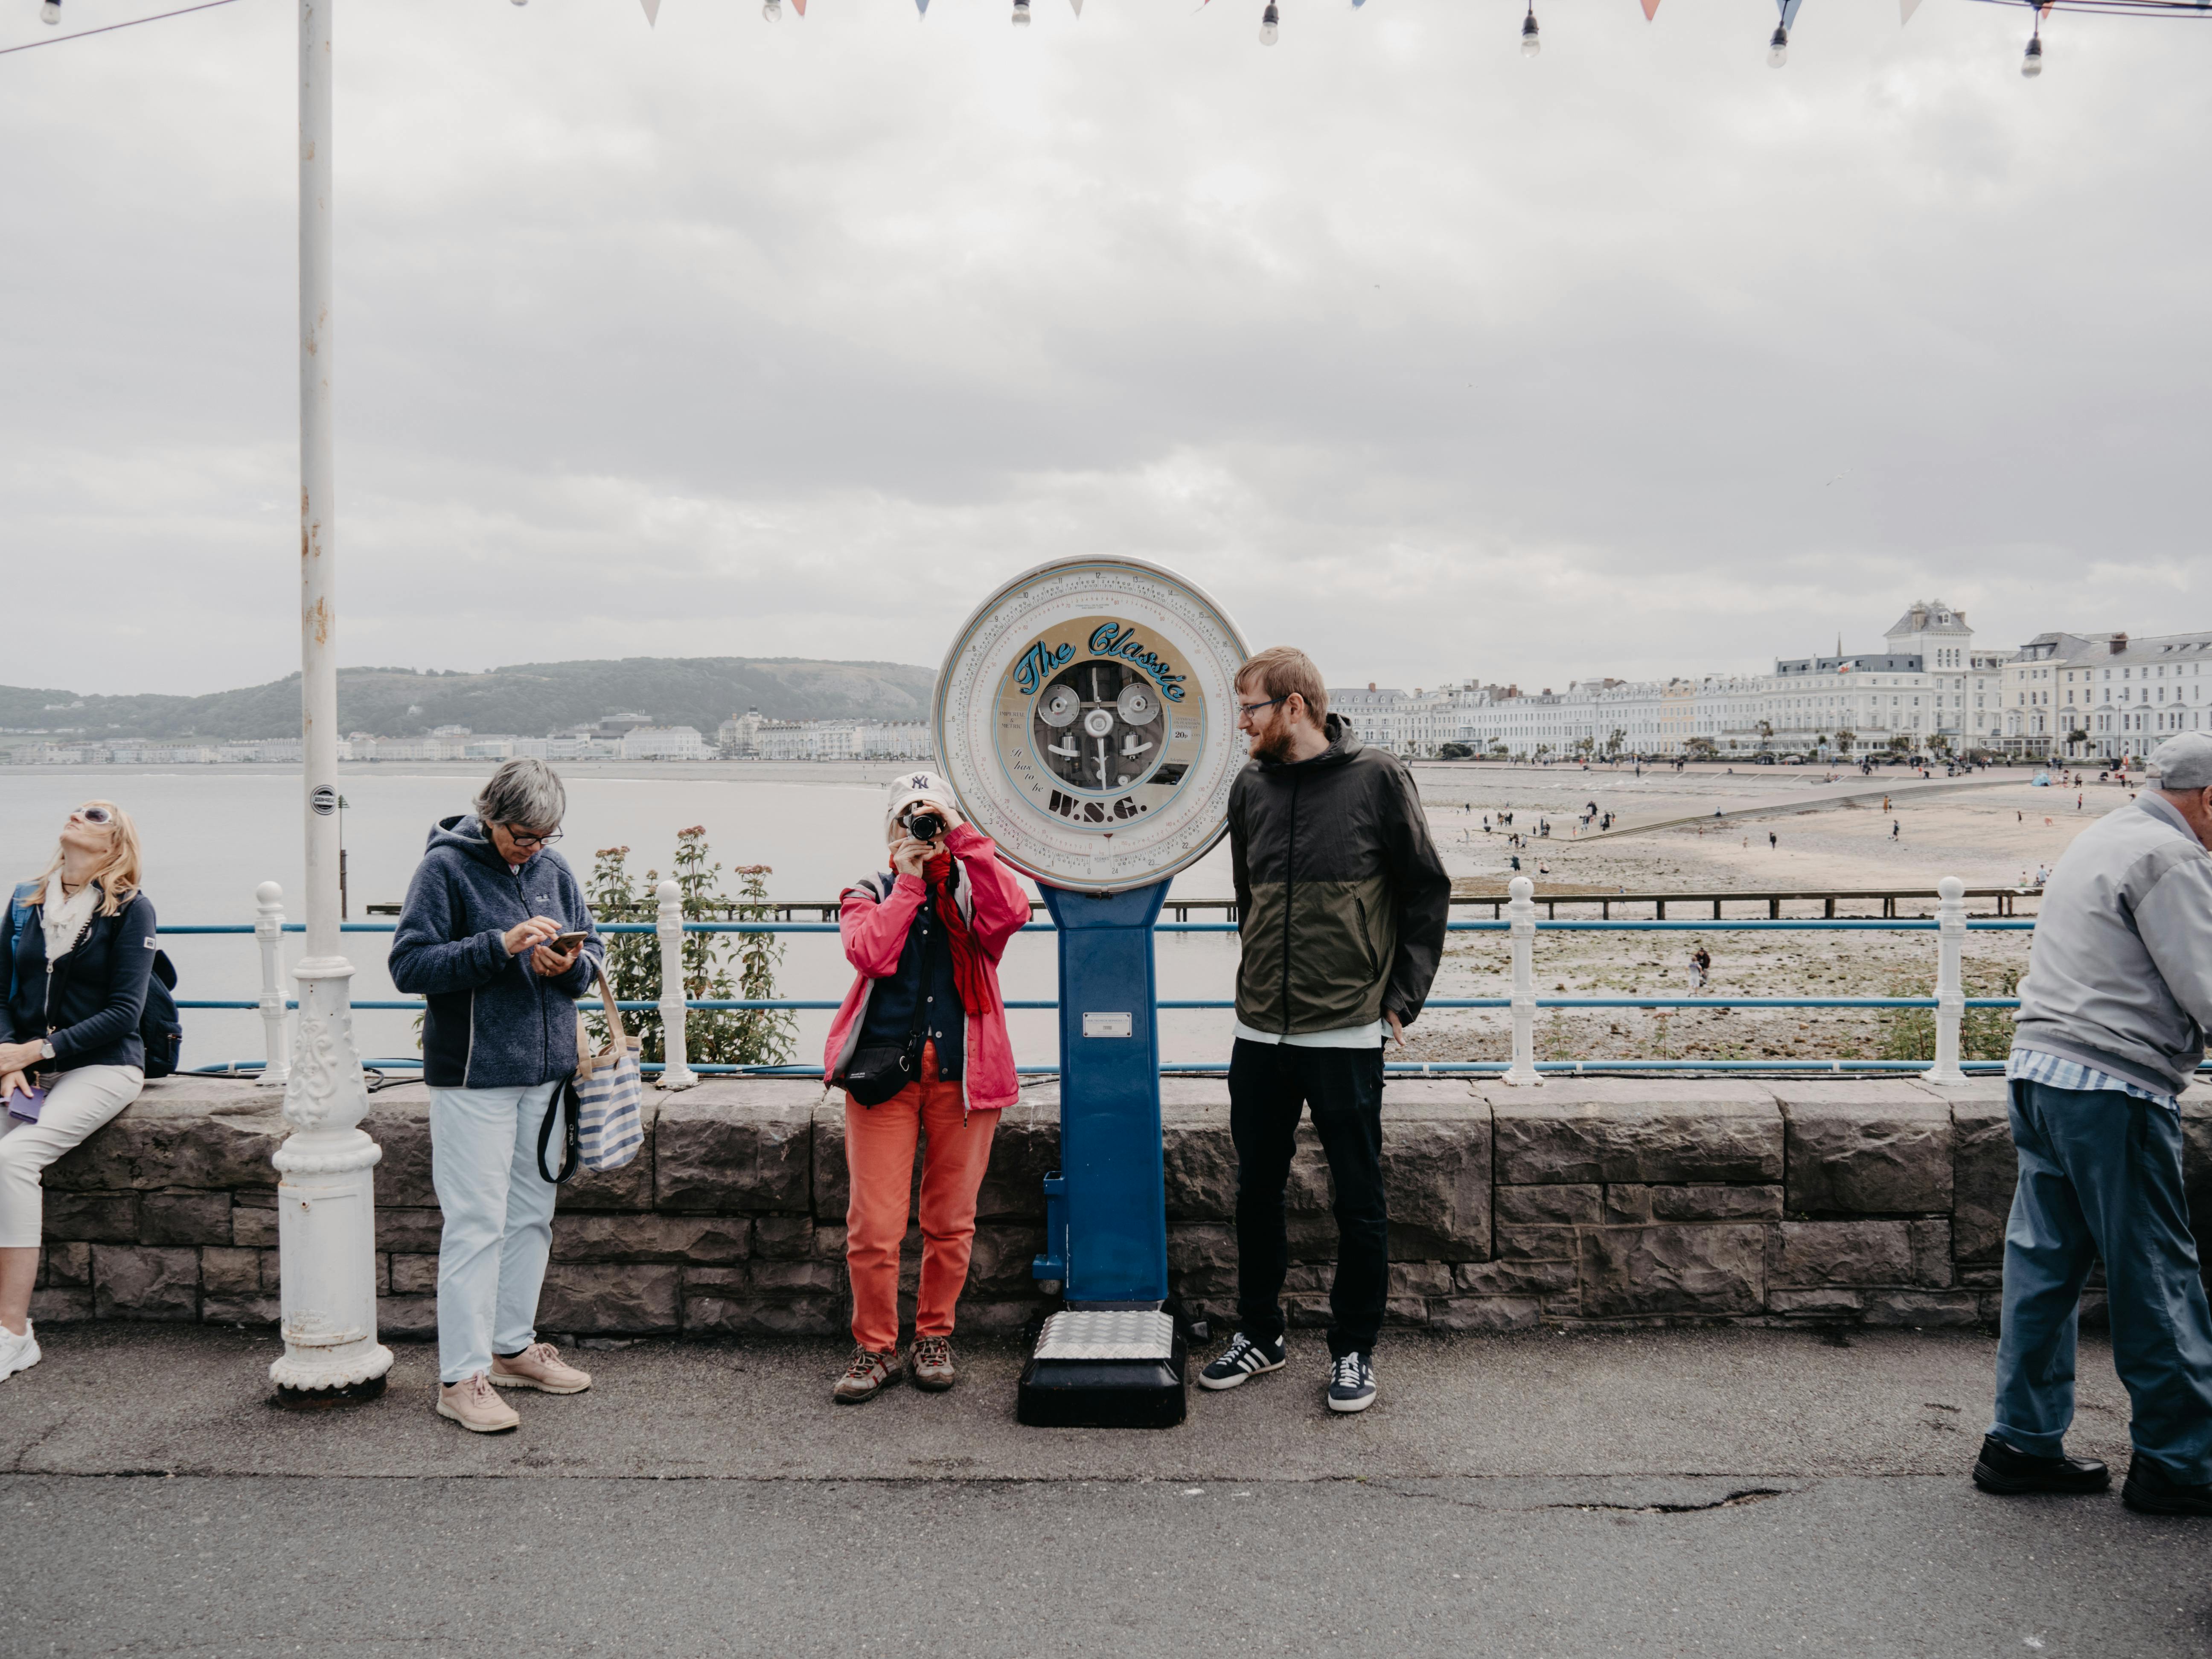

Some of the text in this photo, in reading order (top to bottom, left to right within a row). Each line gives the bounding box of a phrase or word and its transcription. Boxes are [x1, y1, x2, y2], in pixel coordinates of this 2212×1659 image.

[1013, 622, 1187, 702] The Classic
[1010, 748, 1022, 757] It
[1014, 761, 1032, 770] has
[912, 775, 929, 789] NY
[1032, 783, 1043, 792] be
[1049, 789, 1147, 823] W.S.G.
